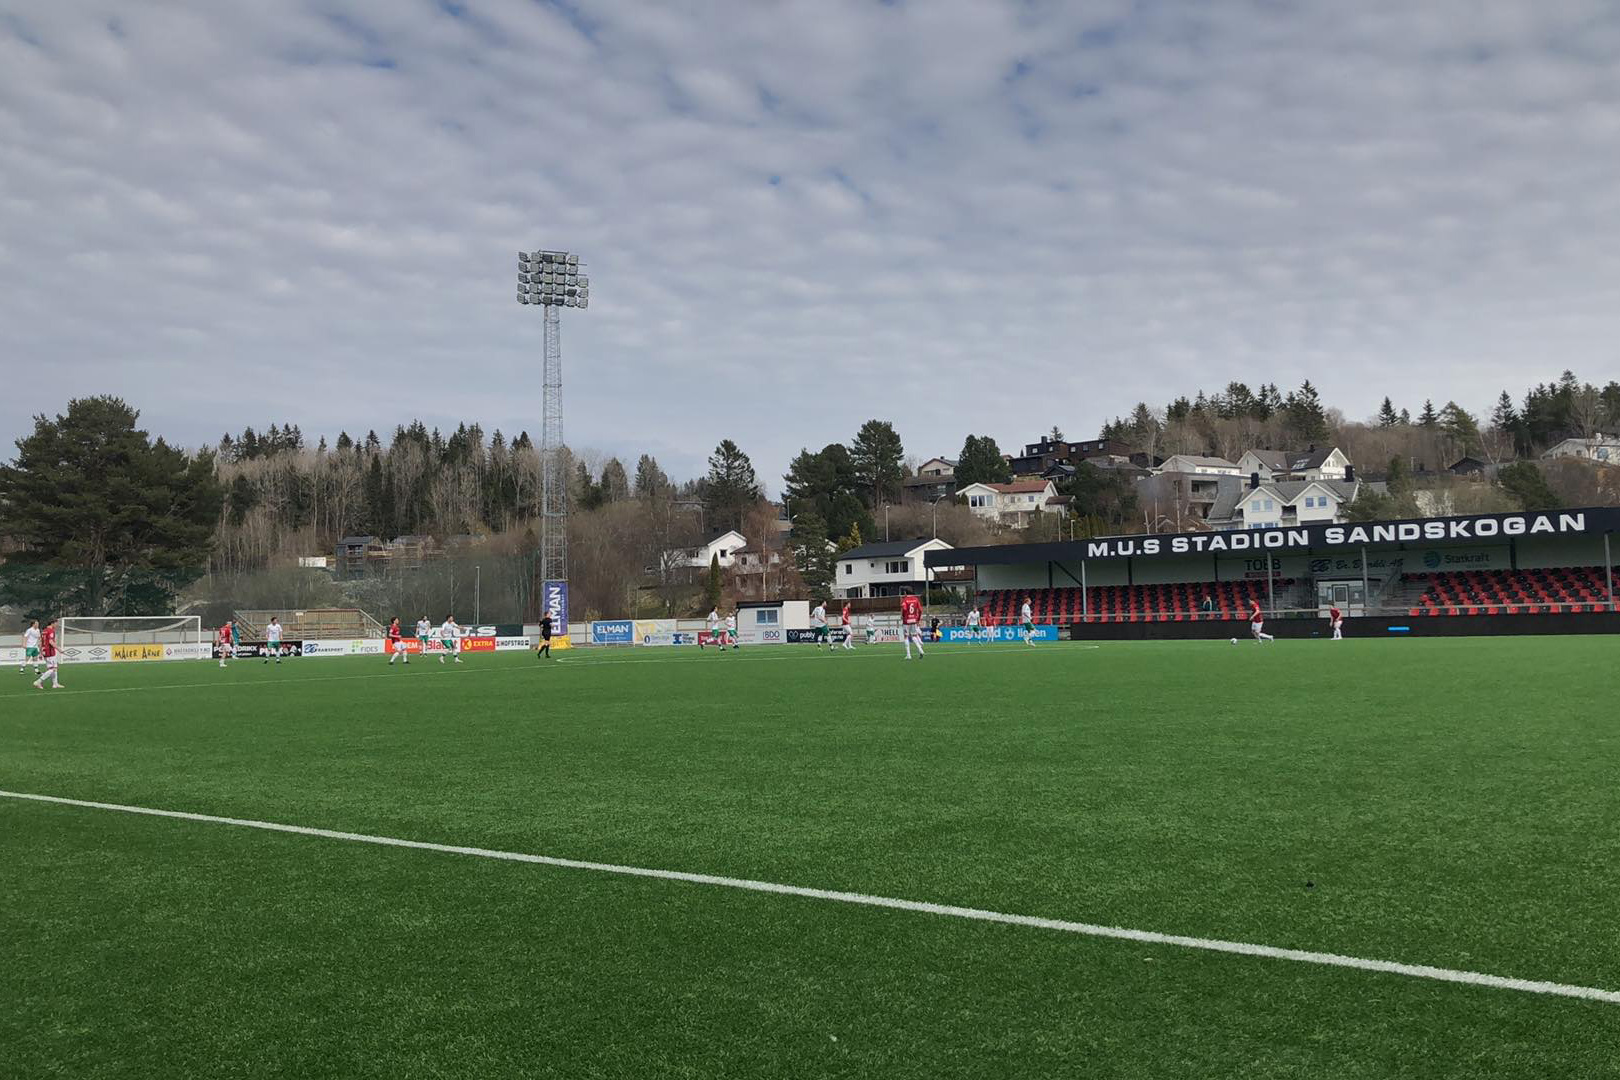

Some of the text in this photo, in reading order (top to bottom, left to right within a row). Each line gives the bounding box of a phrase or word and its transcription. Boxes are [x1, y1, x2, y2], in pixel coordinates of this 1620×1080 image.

[1088, 513, 1585, 557] M.U.S STADION SANDSKOGAN
[1444, 553, 1490, 563] Statkraft
[549, 587, 561, 634] ELMAN
[909, 603, 914, 614] 6
[597, 624, 629, 633] ELMAN
